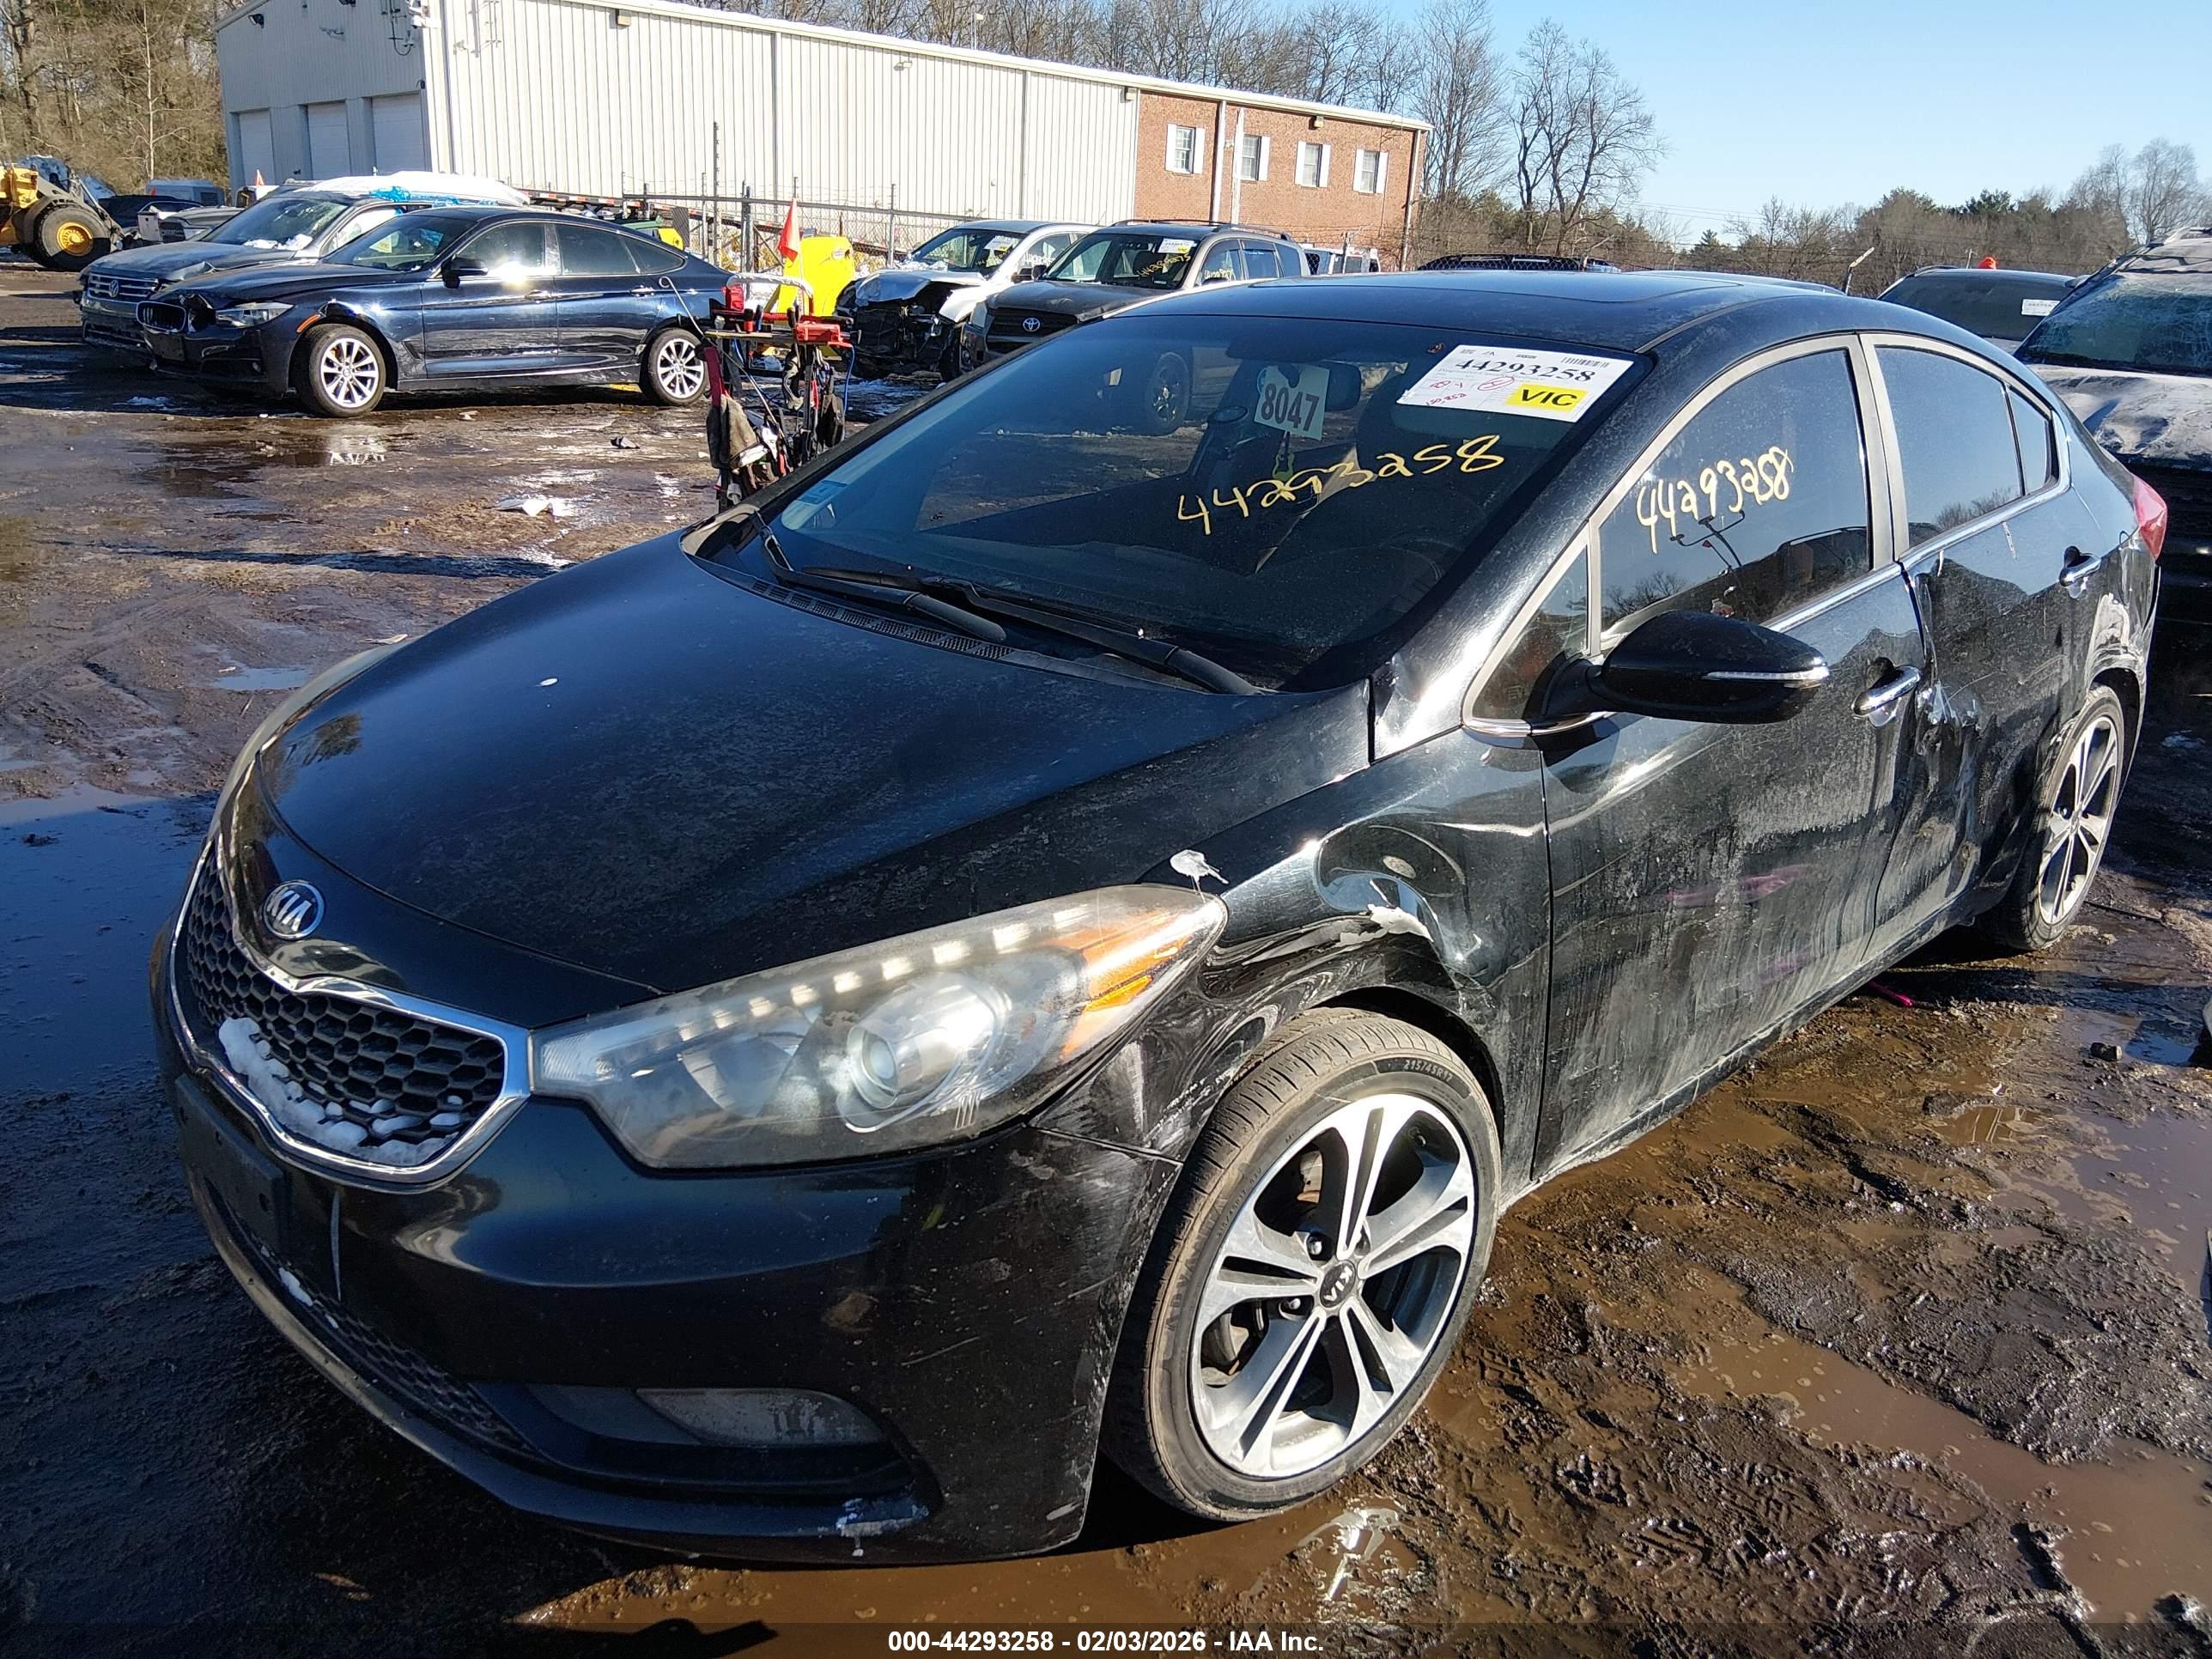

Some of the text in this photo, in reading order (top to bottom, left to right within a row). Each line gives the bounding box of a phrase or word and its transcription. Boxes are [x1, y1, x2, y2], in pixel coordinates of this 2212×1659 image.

[1455, 359, 1595, 382] 44293258
[1261, 383, 1320, 431] 8047
[1521, 389, 1577, 406] VIC
[1177, 434, 1504, 535] 44293258
[1636, 446, 1794, 555] 44293258
[1403, 1059, 1454, 1082] 215/45R17
[1323, 1266, 1353, 1302] KIA
